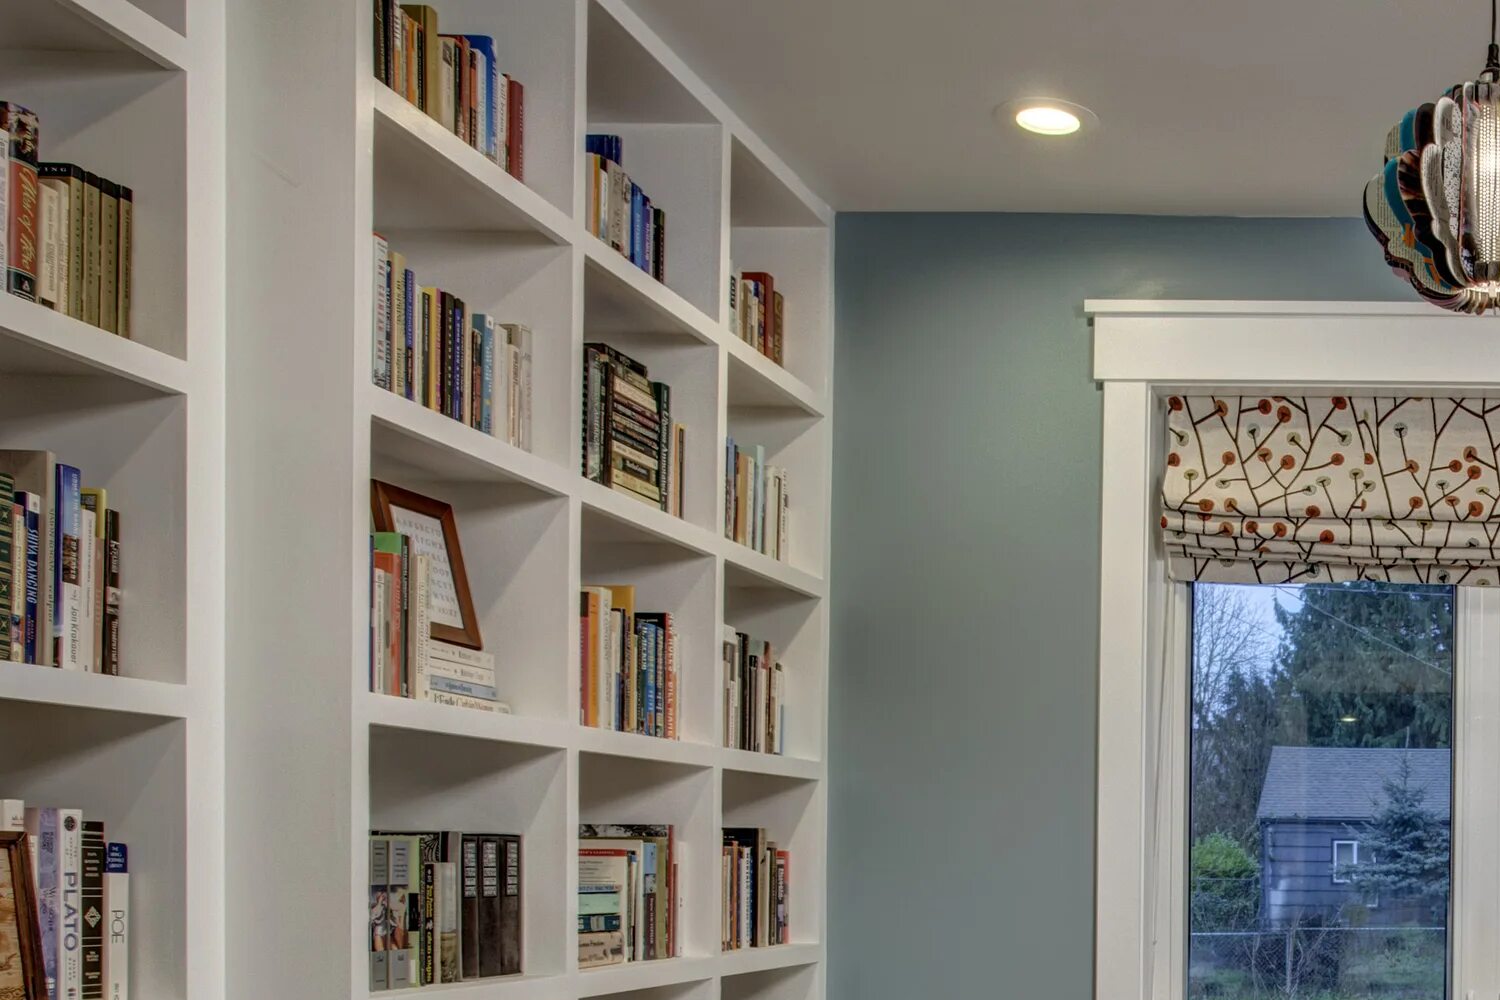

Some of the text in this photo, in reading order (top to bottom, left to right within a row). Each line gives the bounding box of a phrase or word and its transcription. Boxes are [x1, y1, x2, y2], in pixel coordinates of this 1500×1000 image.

[27, 528, 39, 555] SHIVA
[26, 559, 38, 604] DANCING
[70, 623, 79, 664] Krakauer
[64, 872, 79, 951] PLATO
[111, 910, 125, 944] POE
